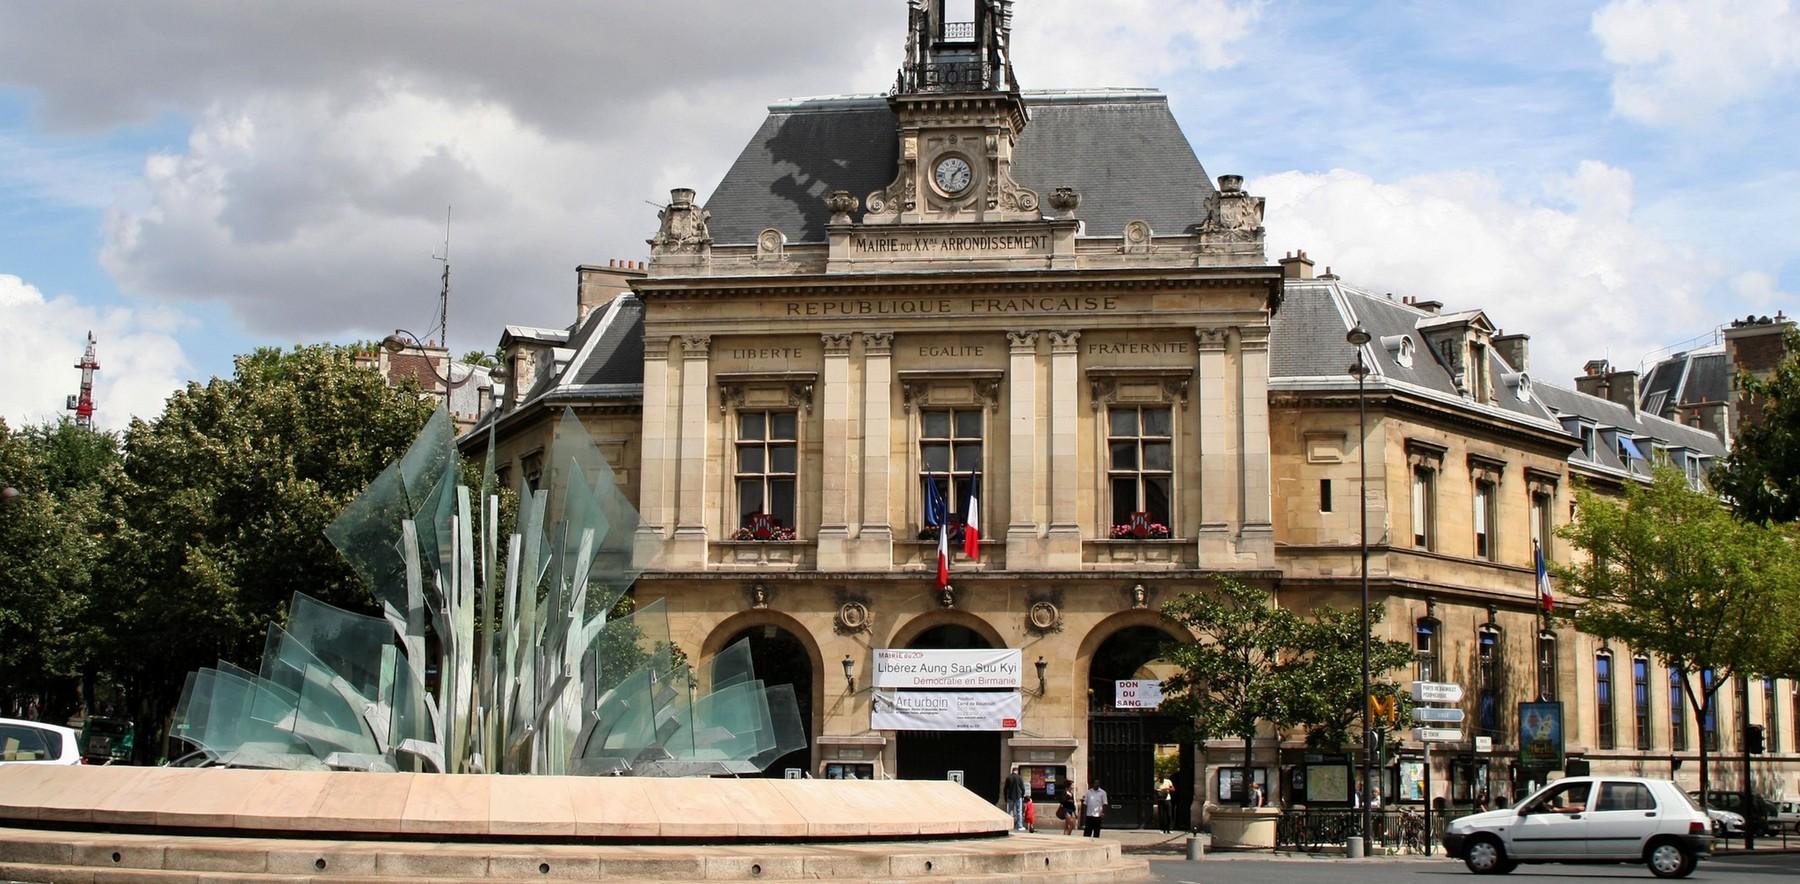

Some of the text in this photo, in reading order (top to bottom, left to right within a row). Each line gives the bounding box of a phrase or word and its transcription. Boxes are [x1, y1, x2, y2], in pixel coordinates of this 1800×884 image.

[856, 238, 898, 253] MAIRIE
[940, 235, 1048, 252] ARRONDISSEMENT
[786, 299, 952, 316] REPUBLIQUE
[733, 347, 803, 360] LIBERTE
[919, 345, 985, 358] EGALITE
[1088, 342, 1189, 355] FRATERNITE
[878, 662, 1017, 675] Libérez Aung San Suu Kyi
[978, 676, 1017, 686] Birmanie
[1122, 690, 1136, 698] DU
[896, 696, 911, 708] Art
[914, 696, 949, 708] urbain
[1368, 694, 1396, 723] M
